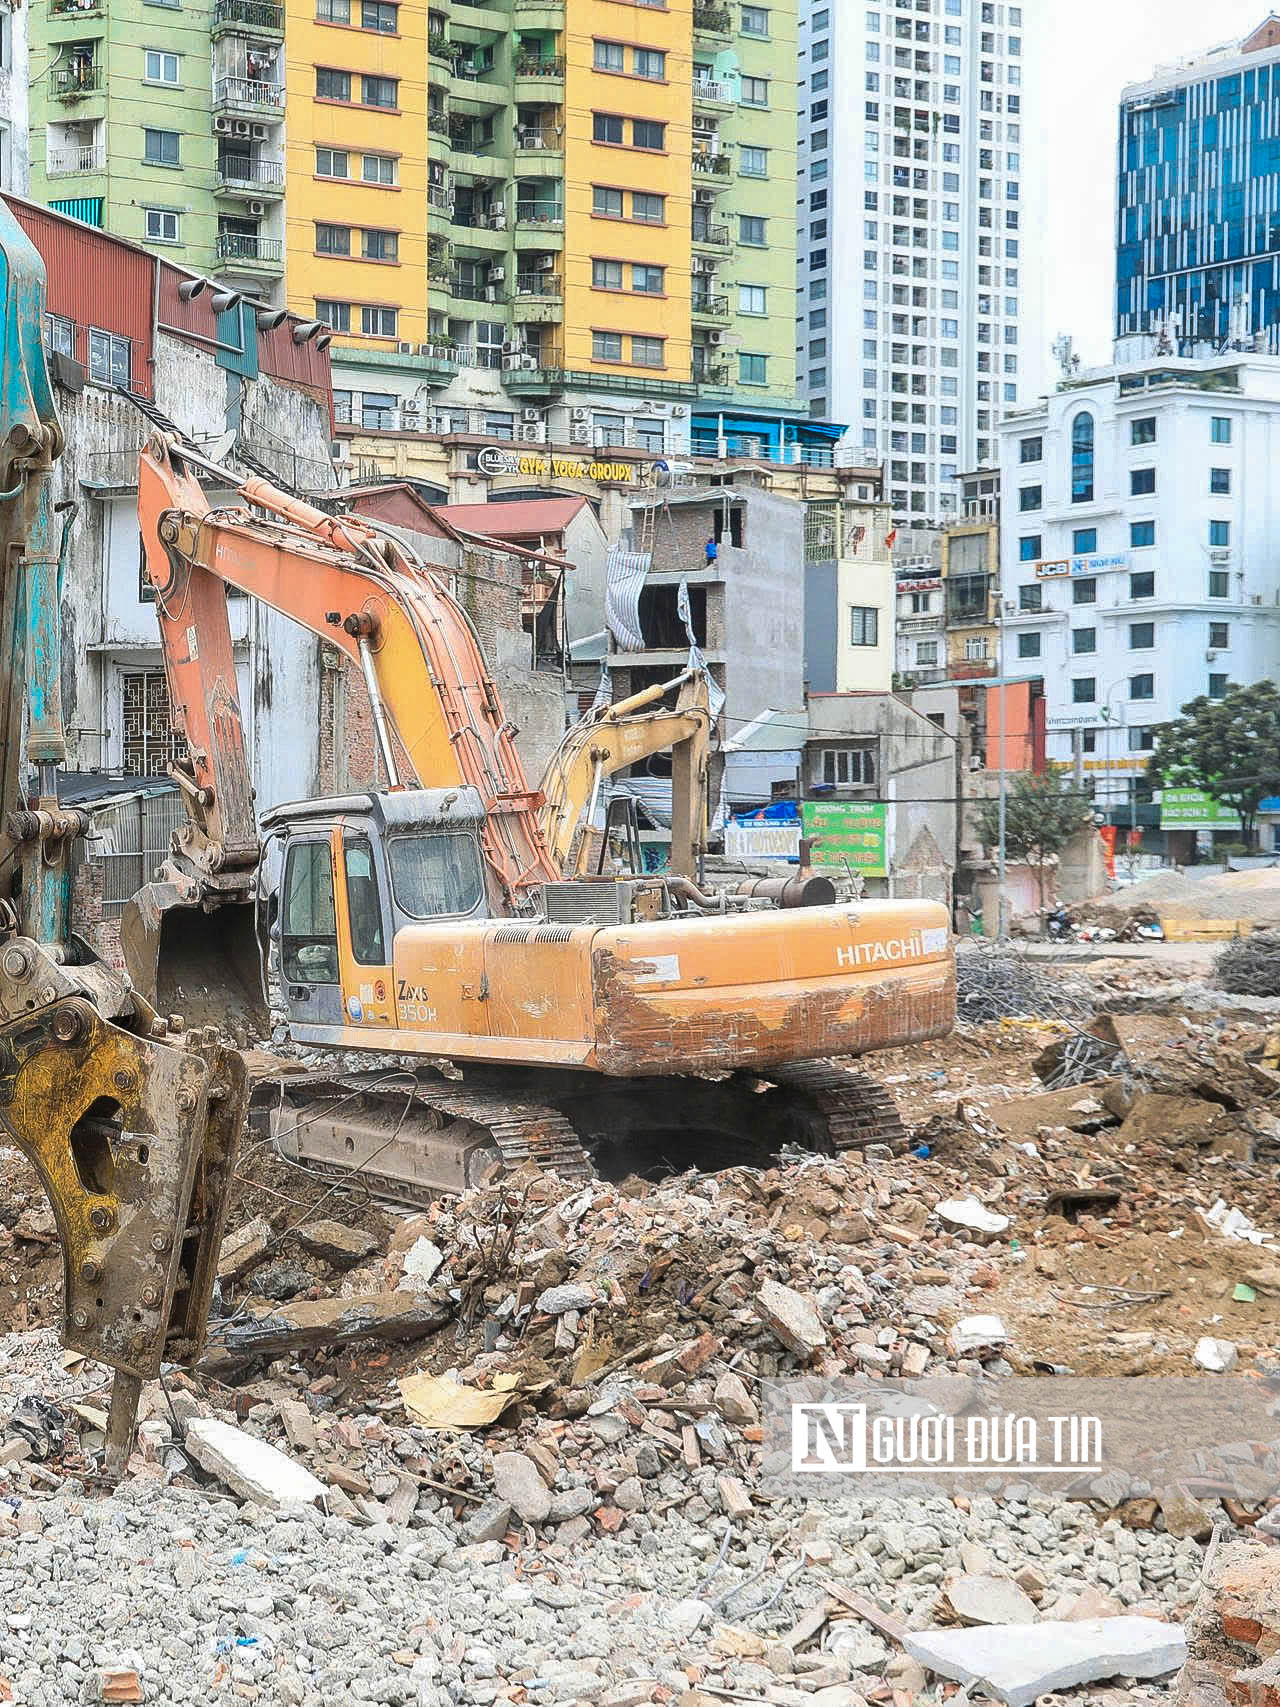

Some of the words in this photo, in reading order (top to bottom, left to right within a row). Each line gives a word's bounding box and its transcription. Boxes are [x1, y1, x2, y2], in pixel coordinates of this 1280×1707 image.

[520, 457, 544, 475] GYM
[552, 460, 581, 480] YOGA
[589, 462, 633, 481] GROUPX
[1037, 562, 1067, 576] JCB
[836, 937, 921, 967] HITACHI
